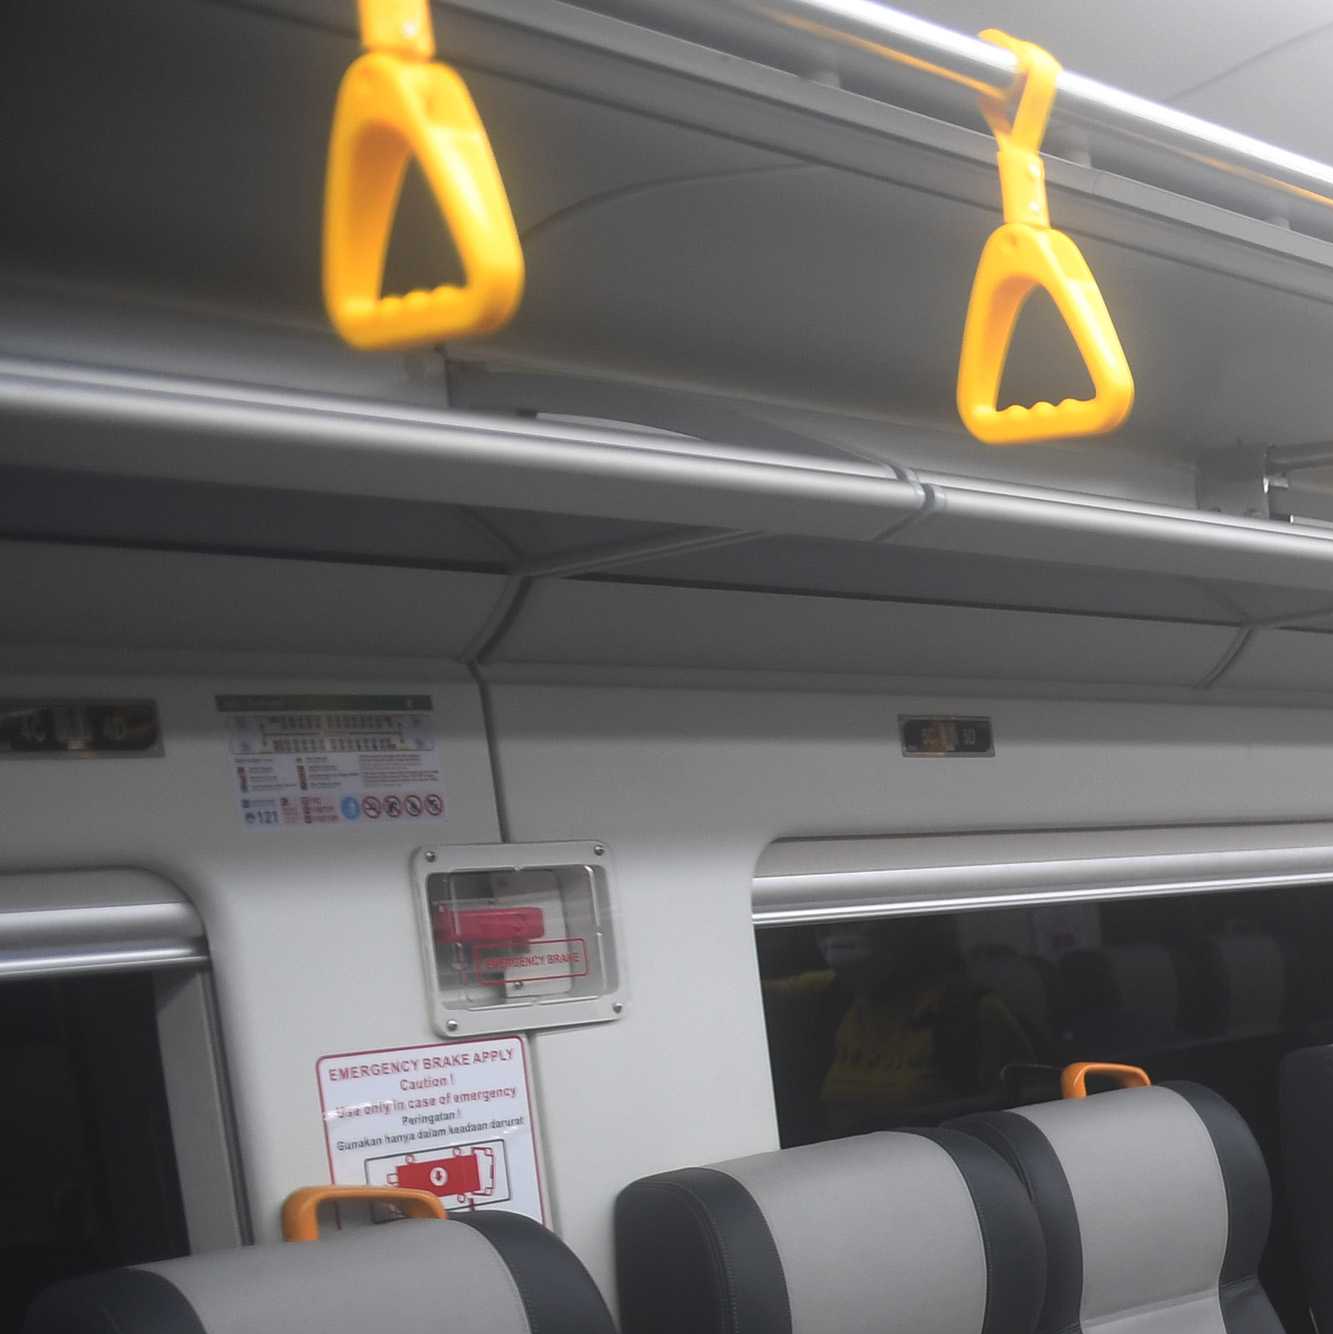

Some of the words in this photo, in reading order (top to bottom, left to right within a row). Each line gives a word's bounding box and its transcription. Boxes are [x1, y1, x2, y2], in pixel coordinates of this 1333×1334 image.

[485, 955, 545, 969] EMERGENCY
[547, 952, 579, 964] BRAKE
[329, 1060, 419, 1081] EMERGENCY
[423, 1053, 470, 1070] BRAKE
[473, 1048, 514, 1064] APPLY
[400, 1075, 447, 1091] Caution
[336, 1105, 360, 1119] Use
[364, 1101, 391, 1117] only
[394, 1099, 405, 1110] in
[408, 1096, 435, 1110] case
[439, 1092, 451, 1105] of
[453, 1086, 517, 1104] emergency
[402, 1112, 456, 1126] Peringatan
[337, 1136, 383, 1151] Gunakan
[385, 1132, 415, 1145] hanya
[417, 1127, 447, 1140] dalam
[449, 1121, 488, 1135] keadaan
[490, 1116, 525, 1130] darurat
